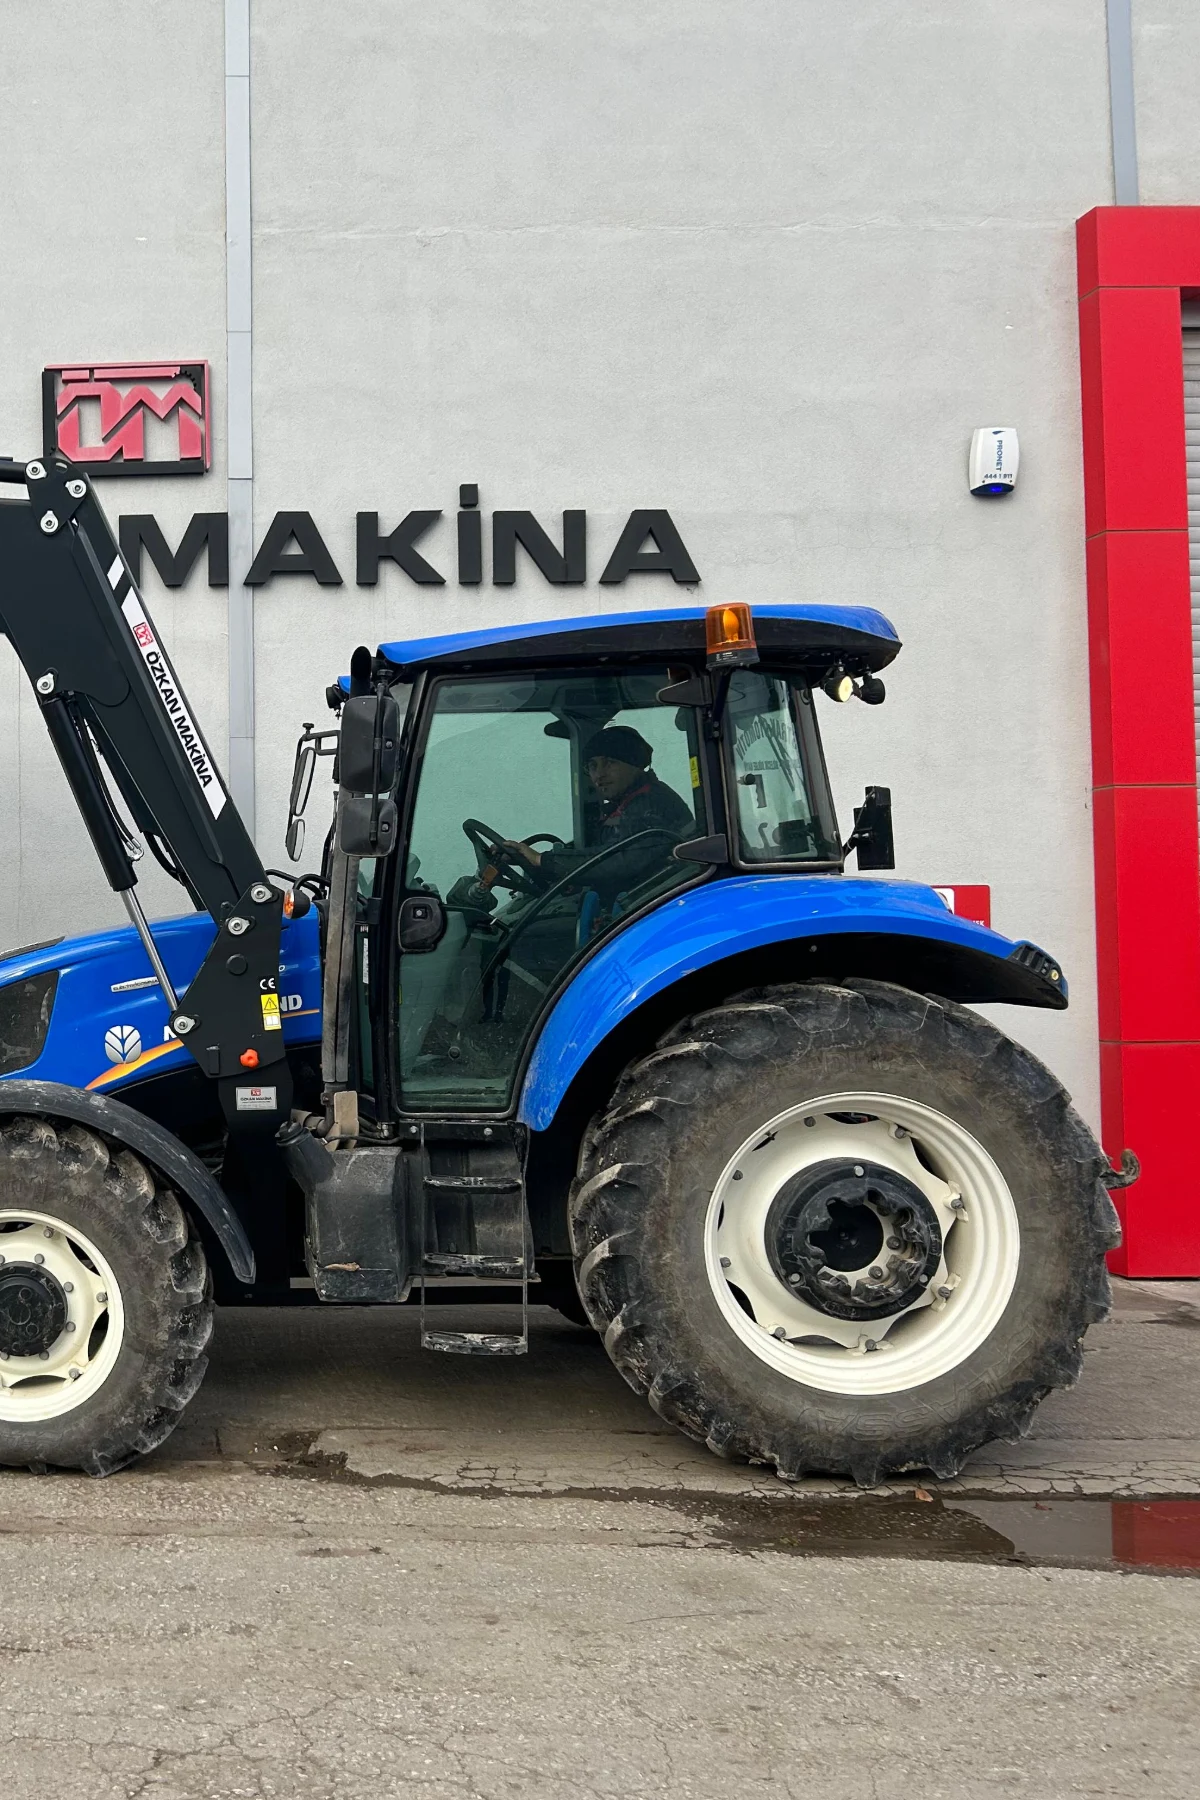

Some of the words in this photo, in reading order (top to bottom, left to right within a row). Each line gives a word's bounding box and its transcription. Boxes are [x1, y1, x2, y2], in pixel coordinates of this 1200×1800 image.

[118, 484, 702, 587] MAKİNA
[146, 651, 181, 714] ÖZKAN
[174, 715, 212, 788] MAKİNA
